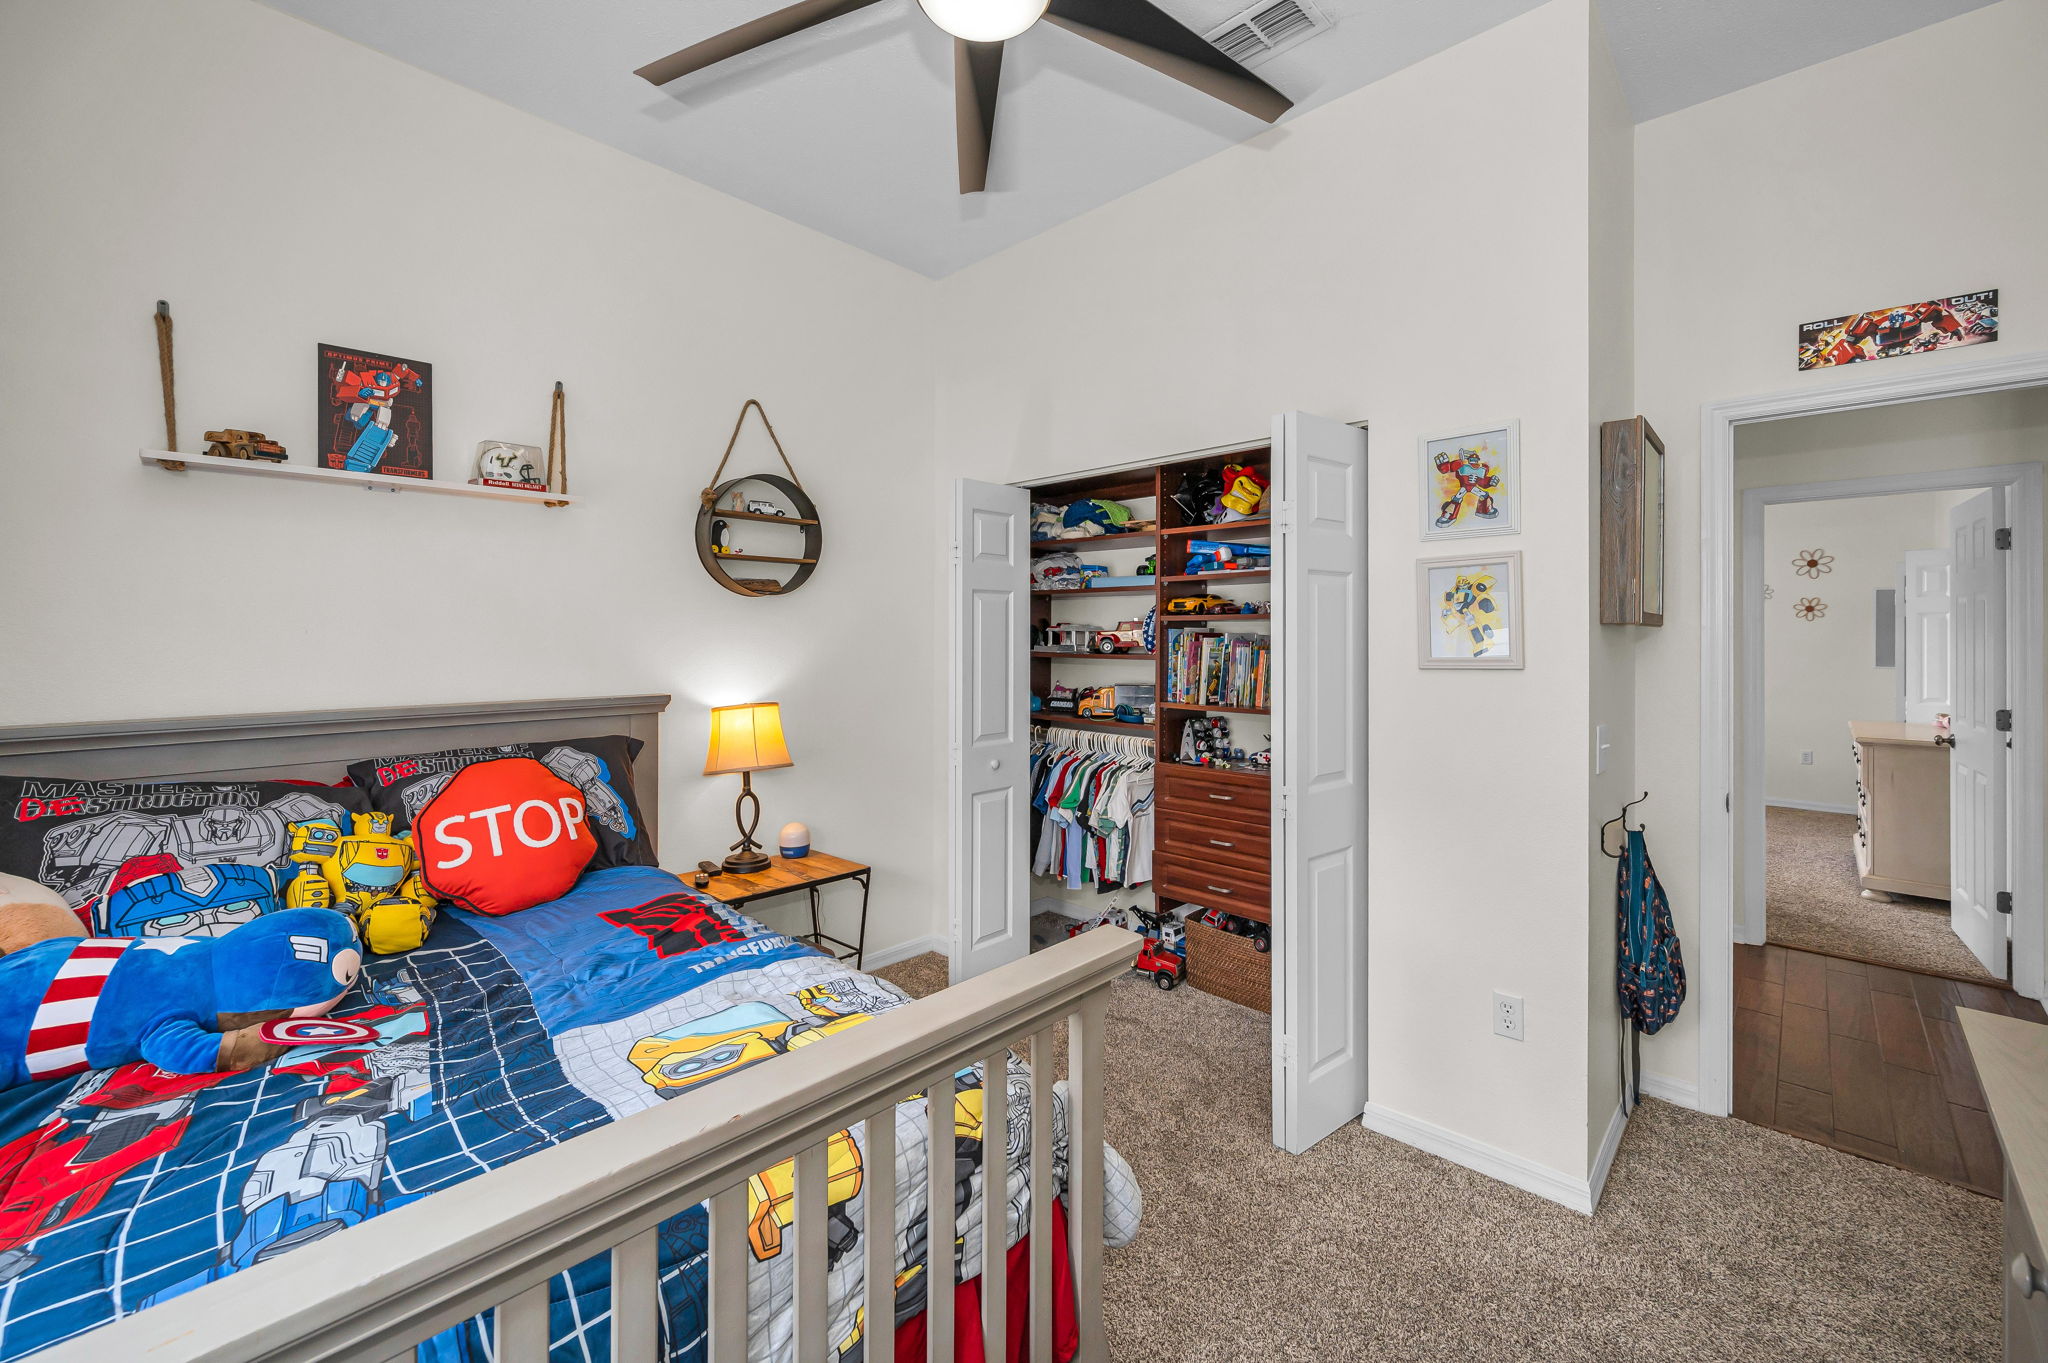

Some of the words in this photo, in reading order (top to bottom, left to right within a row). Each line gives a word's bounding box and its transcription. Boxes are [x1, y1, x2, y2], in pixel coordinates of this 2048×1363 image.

[1803, 320, 1843, 331] ROLL
[1951, 292, 1993, 305] OUT!
[327, 352, 363, 362] OPTIMUS
[365, 357, 390, 367] PRIME
[384, 466, 424, 477] TRANSFORMERS
[434, 797, 584, 870] STOP
